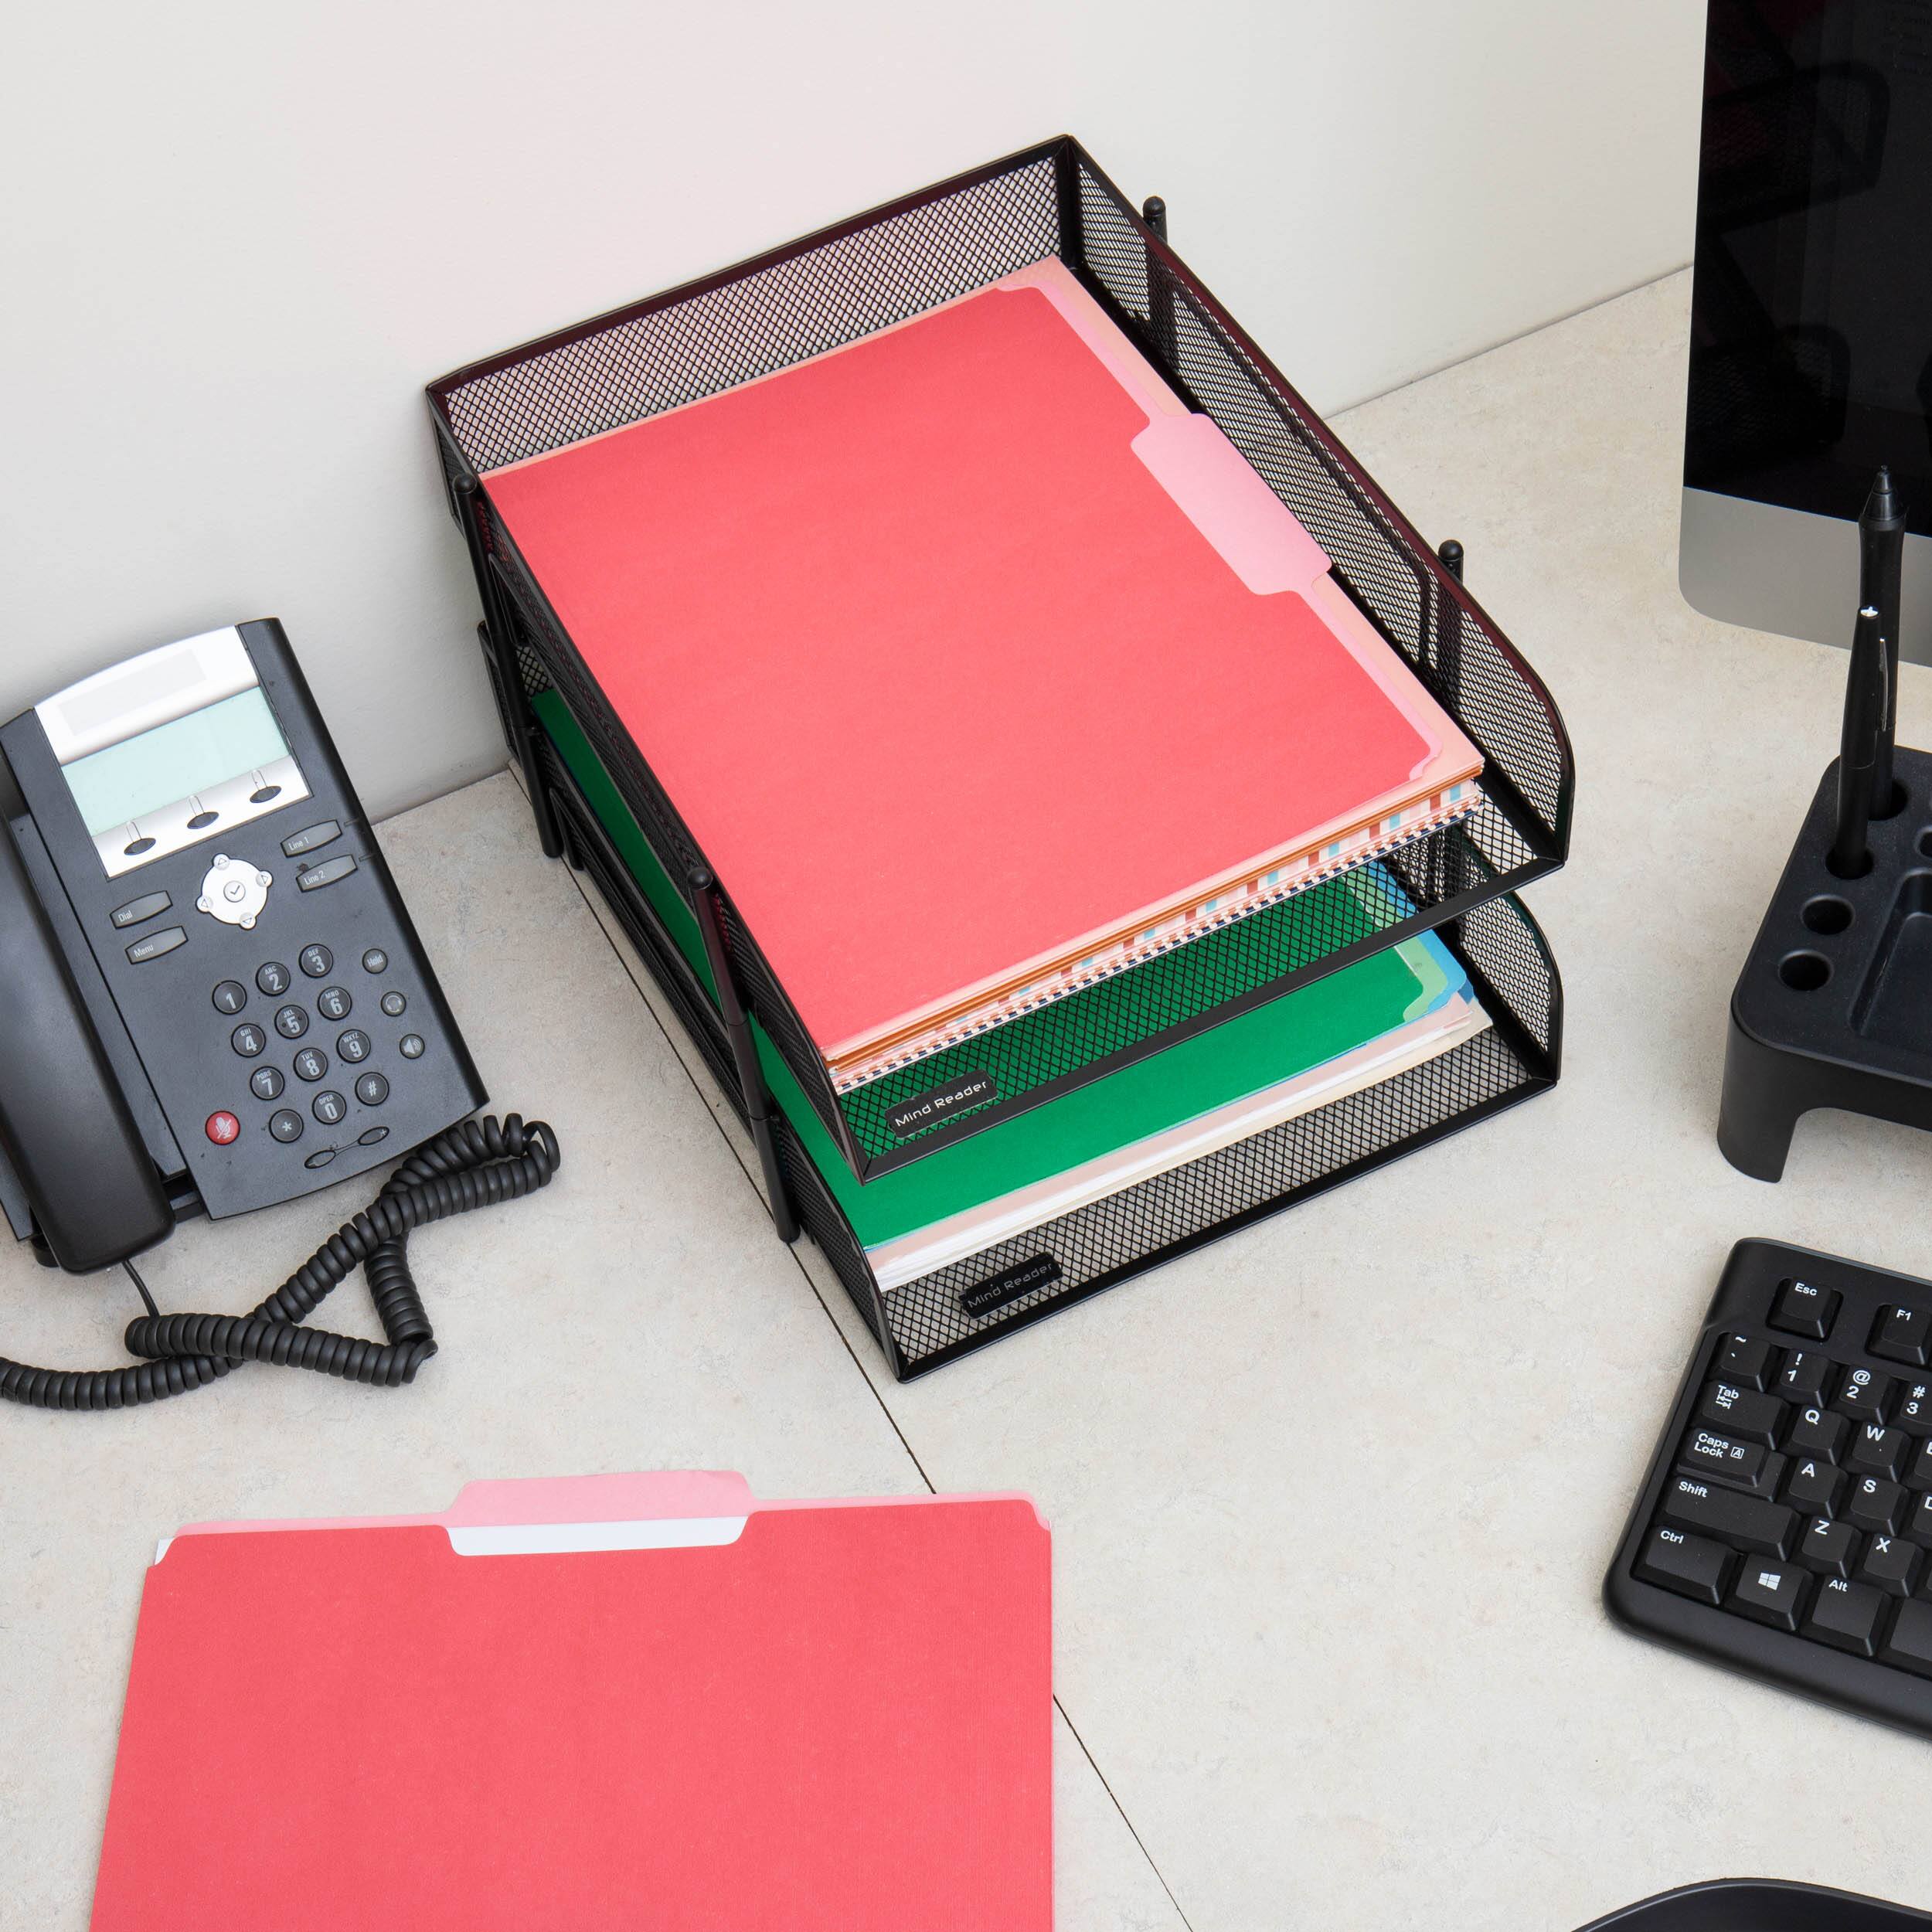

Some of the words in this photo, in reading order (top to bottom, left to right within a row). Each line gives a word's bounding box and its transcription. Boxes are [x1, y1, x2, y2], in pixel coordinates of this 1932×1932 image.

[288, 840, 304, 851] Line
[304, 835, 310, 845] 1
[304, 874, 318, 886] Line
[318, 870, 326, 880] 2
[117, 910, 133, 922] Dial
[133, 944, 154, 957] Menu
[308, 947, 320, 957] DEF
[311, 955, 325, 972] 3
[366, 954, 383, 967] Hold
[264, 965, 277, 975] ABC
[268, 973, 283, 991] 2
[226, 992, 236, 1009] 1
[329, 998, 343, 1015] 6
[283, 1009, 295, 1018] JKL
[240, 1027, 252, 1036] GHI
[286, 1015, 301, 1033] 5
[245, 1036, 257, 1052] 4
[342, 1032, 359, 1043] WXYZ
[301, 1051, 314, 1061] TUV
[349, 1041, 362, 1058] 9
[256, 1070, 272, 1081] PQRS
[305, 1059, 320, 1076] 8
[262, 1078, 273, 1095] 7
[368, 1080, 377, 1097] #
[318, 1094, 335, 1105] OPER
[895, 1104, 932, 1128] Mind
[934, 1081, 987, 1110] Reader
[325, 1102, 338, 1120] 0
[967, 1286, 1002, 1308] Mind
[1003, 1263, 1053, 1291] Reader
[1794, 1282, 1818, 1296] Esc
[1896, 1309, 1912, 1321] F1
[1795, 1353, 1803, 1366] !
[1787, 1369, 1797, 1382] 1
[1852, 1370, 1871, 1386] @
[1717, 1384, 1740, 1400] Tab
[1846, 1385, 1860, 1399] 2
[1913, 1386, 1926, 1399] #
[1906, 1402, 1919, 1415] 3
[1804, 1409, 1820, 1425] Q
[1866, 1425, 1886, 1441] W
[1694, 1440, 1724, 1458] Lock
[1698, 1433, 1729, 1451] Caps
[1801, 1463, 1815, 1478] A
[1679, 1481, 1708, 1498] Shift
[1862, 1479, 1876, 1493] S
[1815, 1519, 1830, 1536] Z
[1660, 1530, 1684, 1544] Ctrl
[1876, 1537, 1891, 1553] X
[1828, 1579, 1848, 1592] Alt
